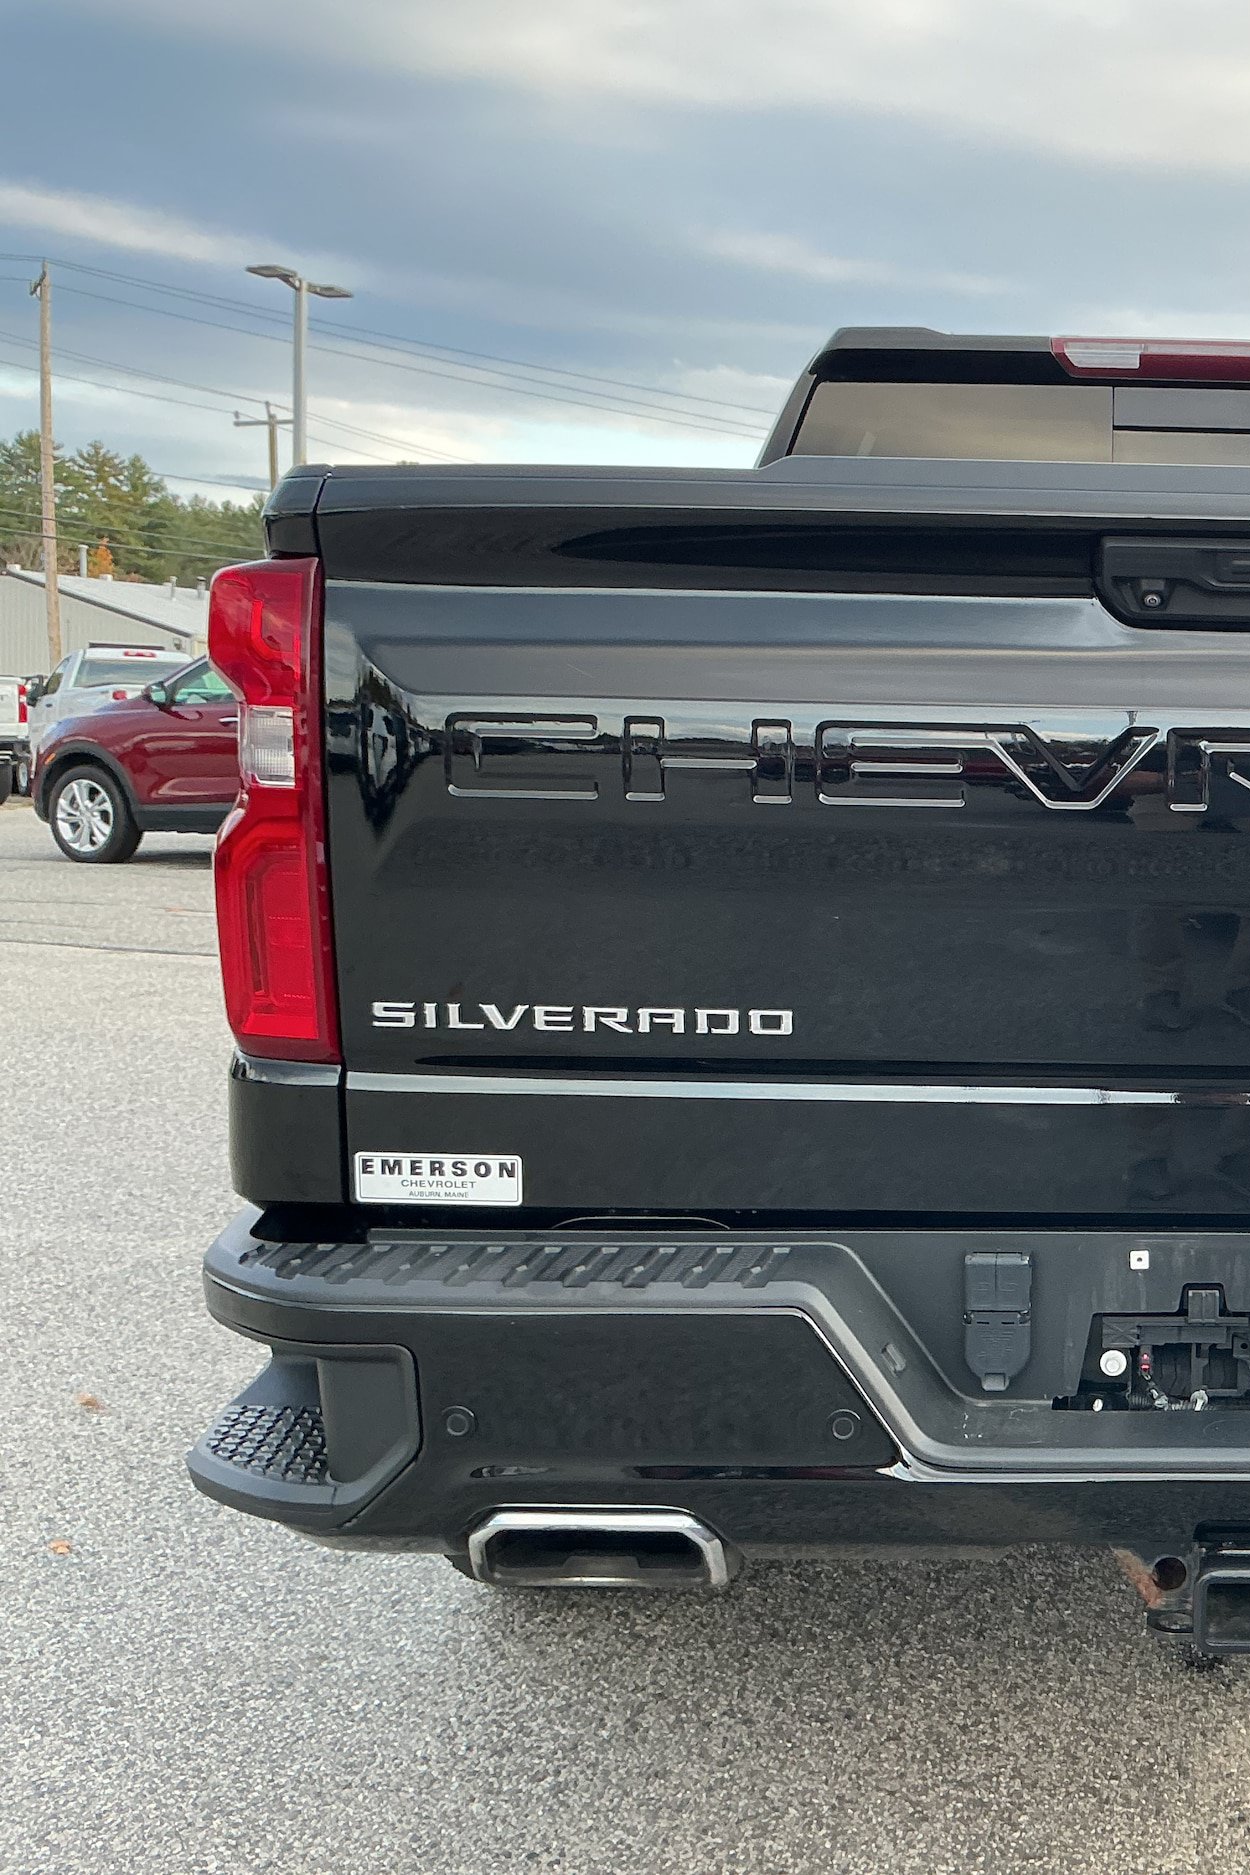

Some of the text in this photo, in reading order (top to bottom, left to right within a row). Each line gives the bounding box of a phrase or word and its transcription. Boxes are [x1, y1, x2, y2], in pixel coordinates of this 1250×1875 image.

[371, 1001, 794, 1036] SILVERADO
[361, 1158, 516, 1178] EMERSON
[400, 1179, 477, 1189] CHEVROLET
[444, 1191, 469, 1199] MAINE
